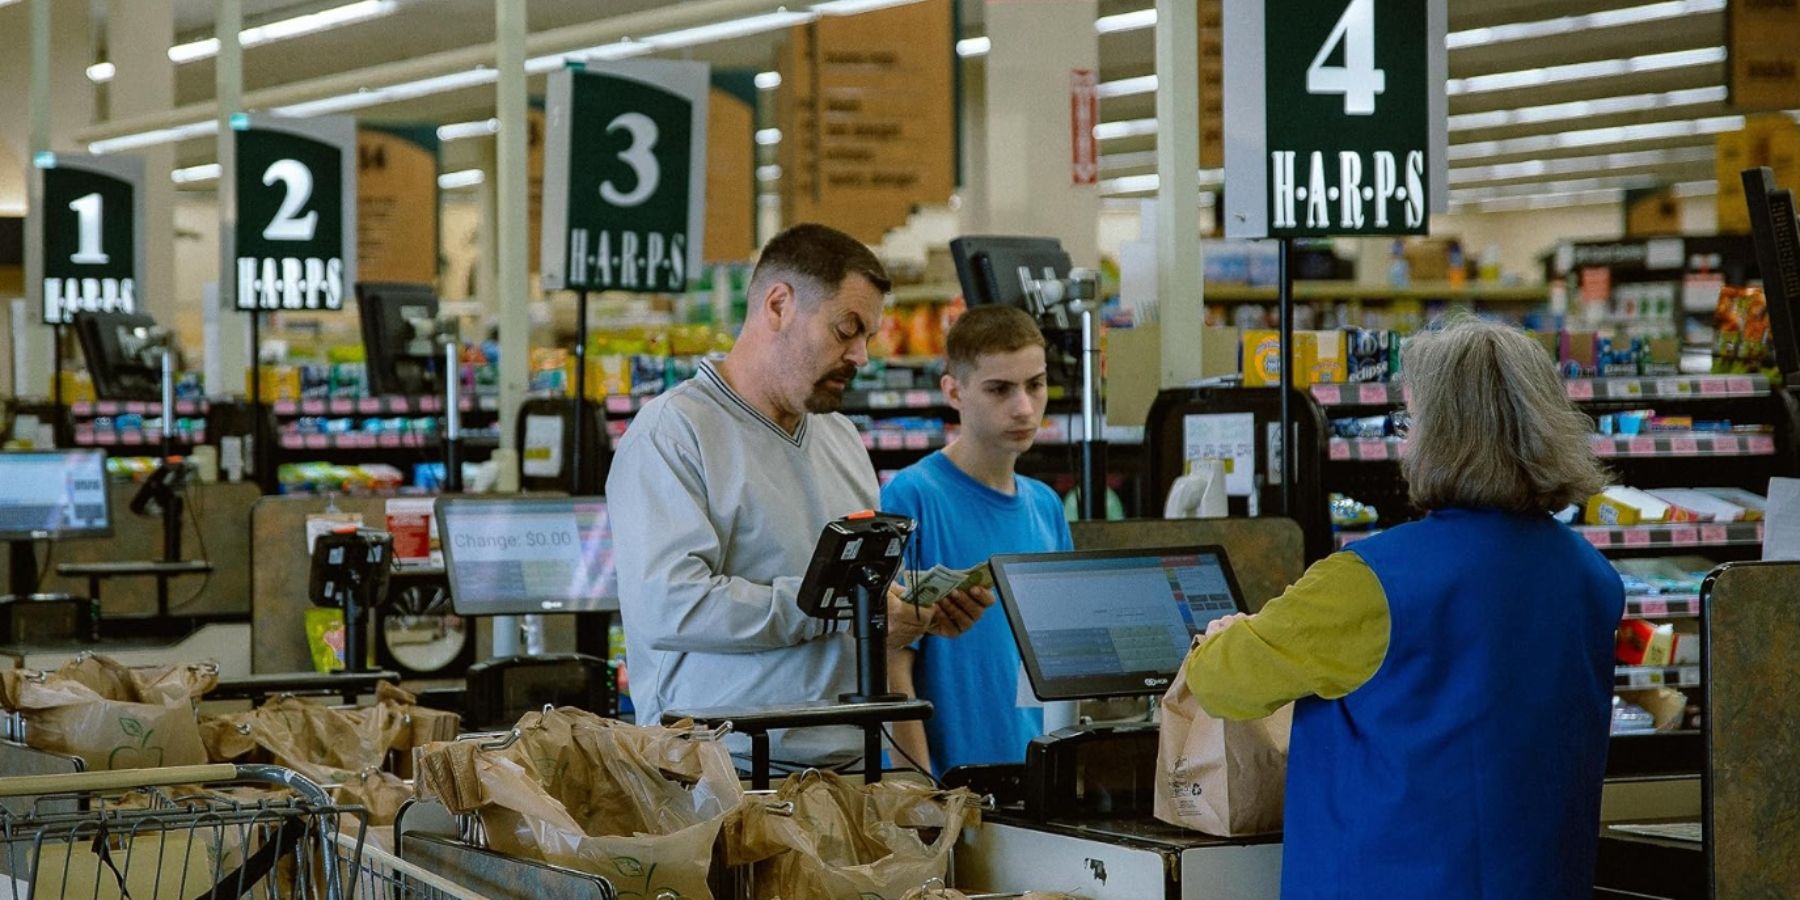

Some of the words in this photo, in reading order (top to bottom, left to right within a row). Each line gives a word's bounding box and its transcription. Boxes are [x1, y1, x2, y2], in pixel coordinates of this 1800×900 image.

[1306, 0, 1386, 115] 4
[599, 112, 661, 207] 3
[69, 193, 110, 264] 1
[262, 159, 319, 241] 2
[1348, 361, 1388, 384] eclipse
[454, 532, 521, 549] Change:
[526, 531, 571, 547] $0.00
